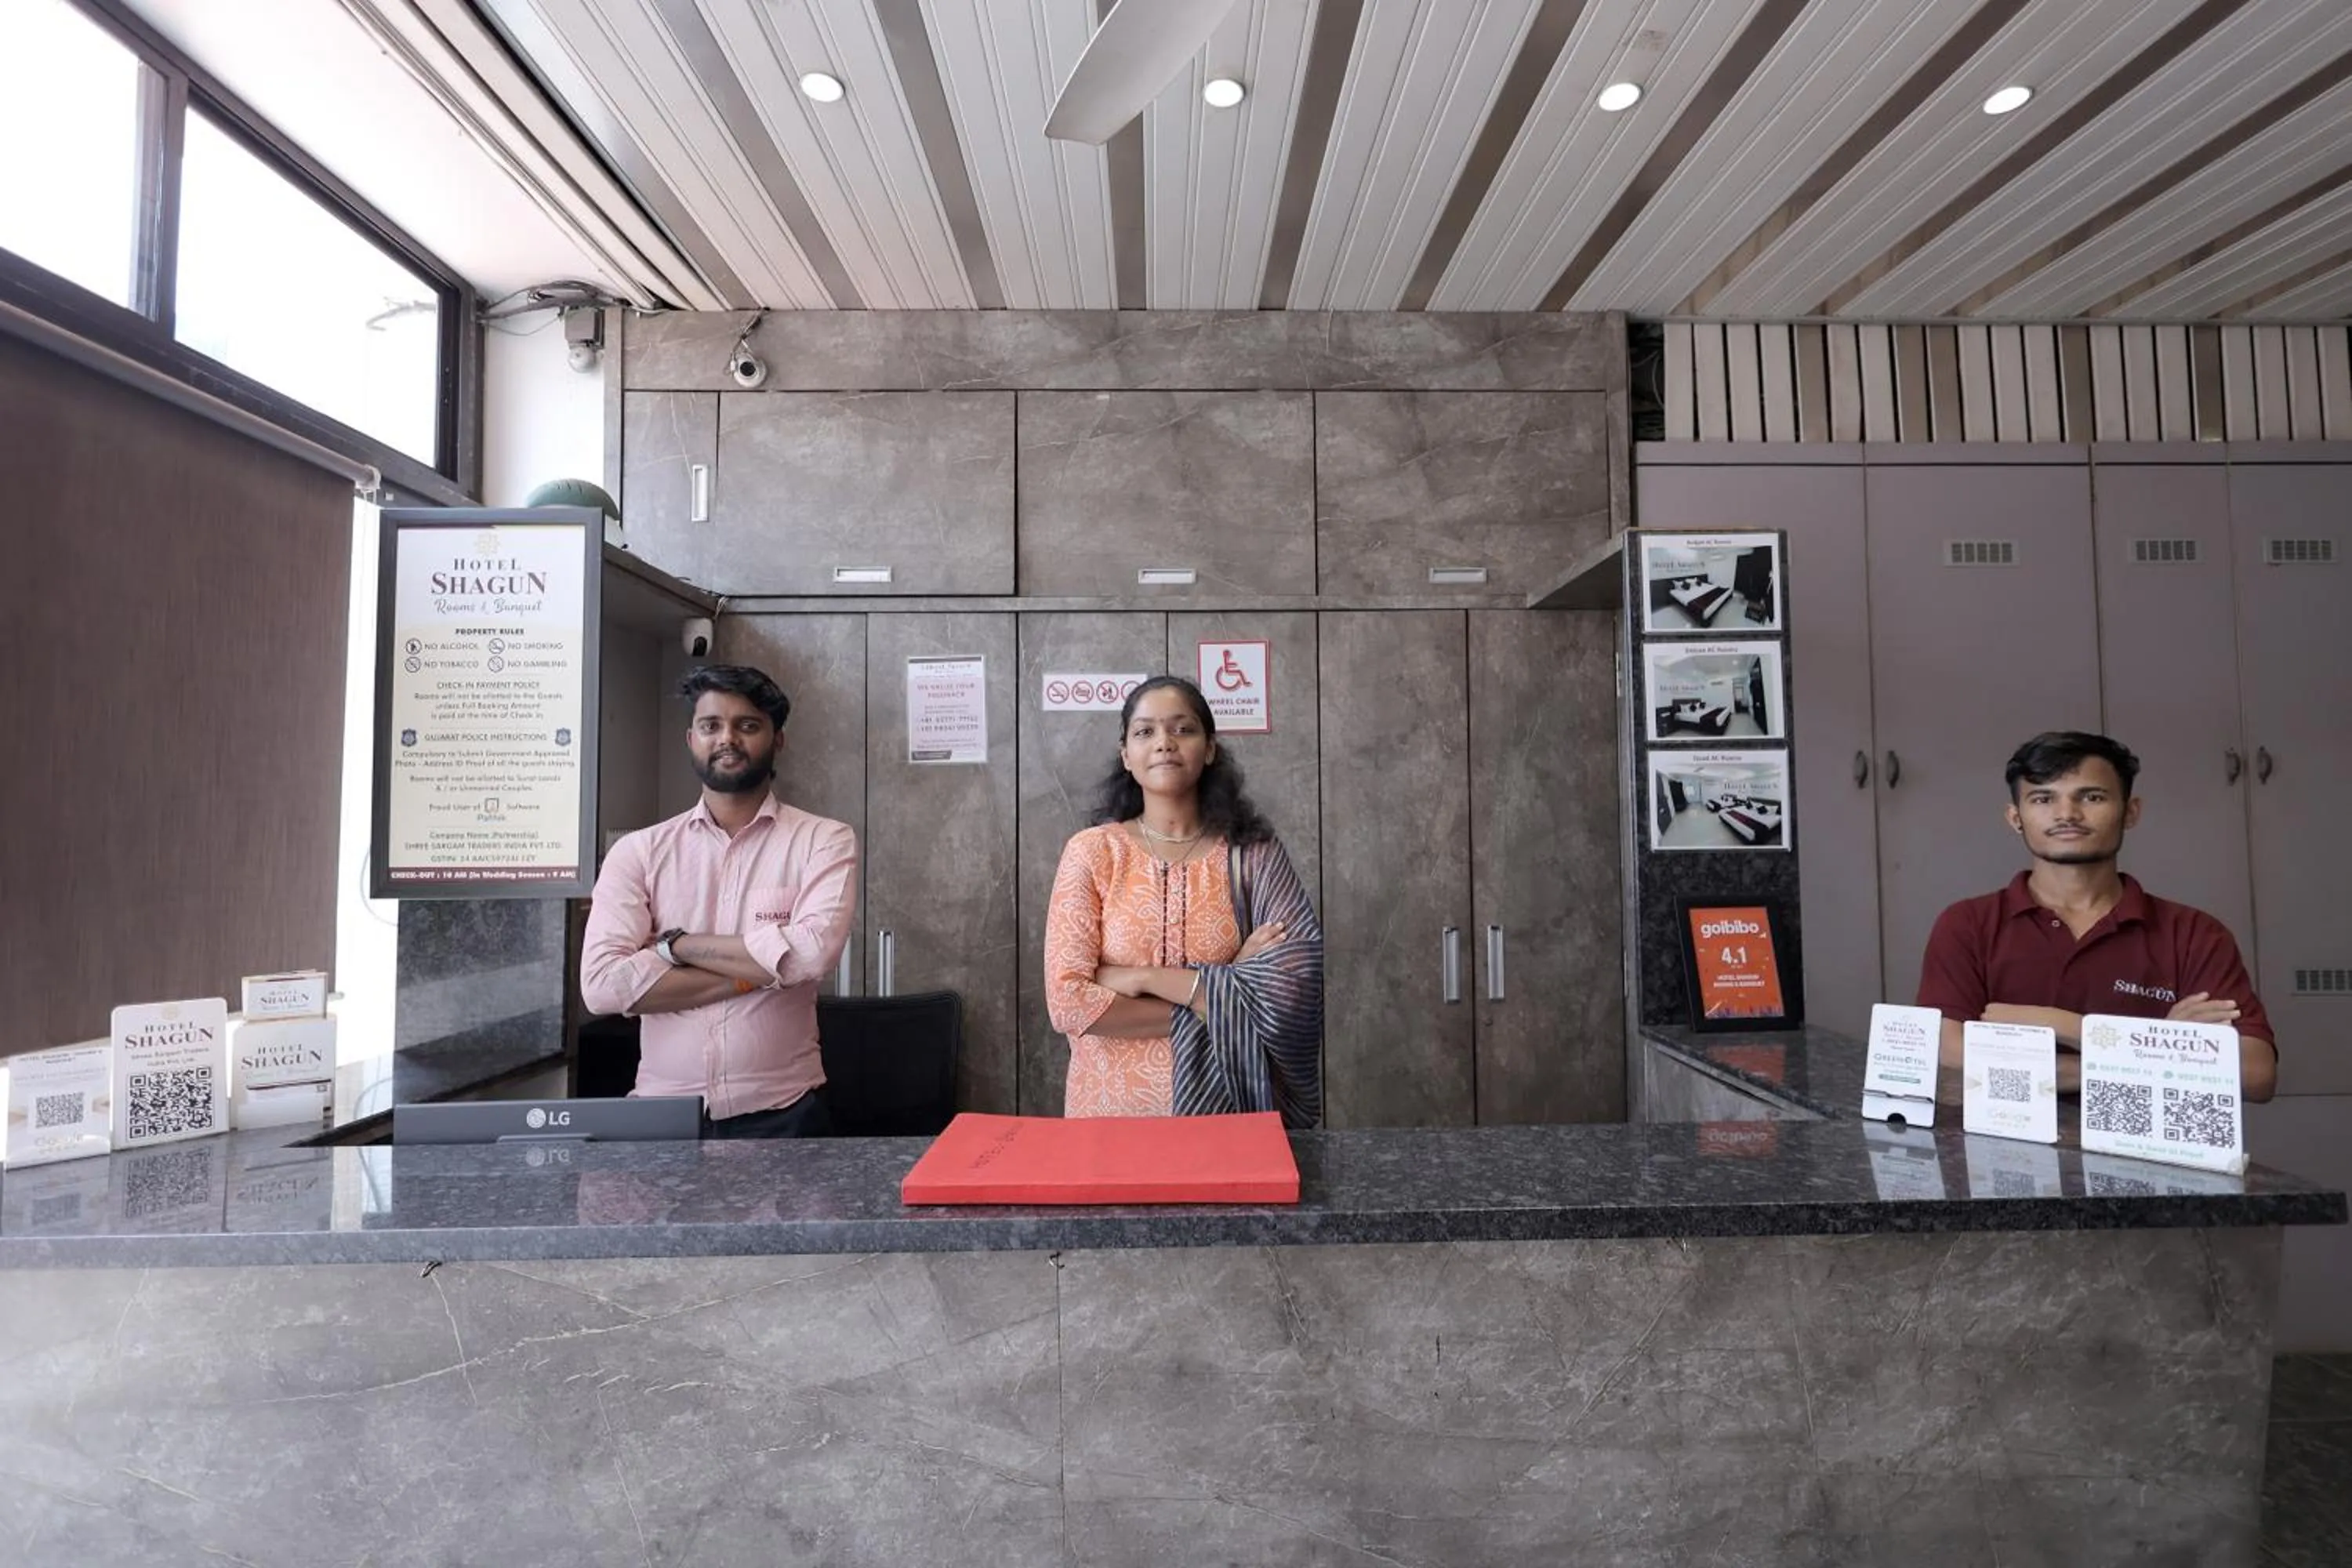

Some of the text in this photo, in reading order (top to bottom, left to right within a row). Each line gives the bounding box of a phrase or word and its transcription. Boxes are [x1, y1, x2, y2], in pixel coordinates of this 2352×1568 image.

[453, 557, 522, 572] HOTEL
[430, 572, 547, 595] SHAGUN
[434, 598, 475, 615] Rooms
[493, 597, 543, 617] Banquet
[423, 660, 480, 669] NO TOBACCO
[423, 732, 548, 742] GUJARAT POLICE INSTRUCTIONS
[1700, 920, 1760, 938] goibibo
[1721, 946, 1748, 964] 4.1
[260, 993, 310, 1004] SHAGUN
[2114, 978, 2177, 1003] SHAGUN
[145, 1021, 196, 1034] HOTEL
[2148, 1025, 2202, 1039] HOTEL
[125, 1027, 215, 1049] SHAGUN
[2129, 1033, 2220, 1054] SHAGUN
[257, 1043, 303, 1054] HOTEL
[241, 1049, 323, 1070] SHAGUN
[548, 1111, 571, 1126] LG
